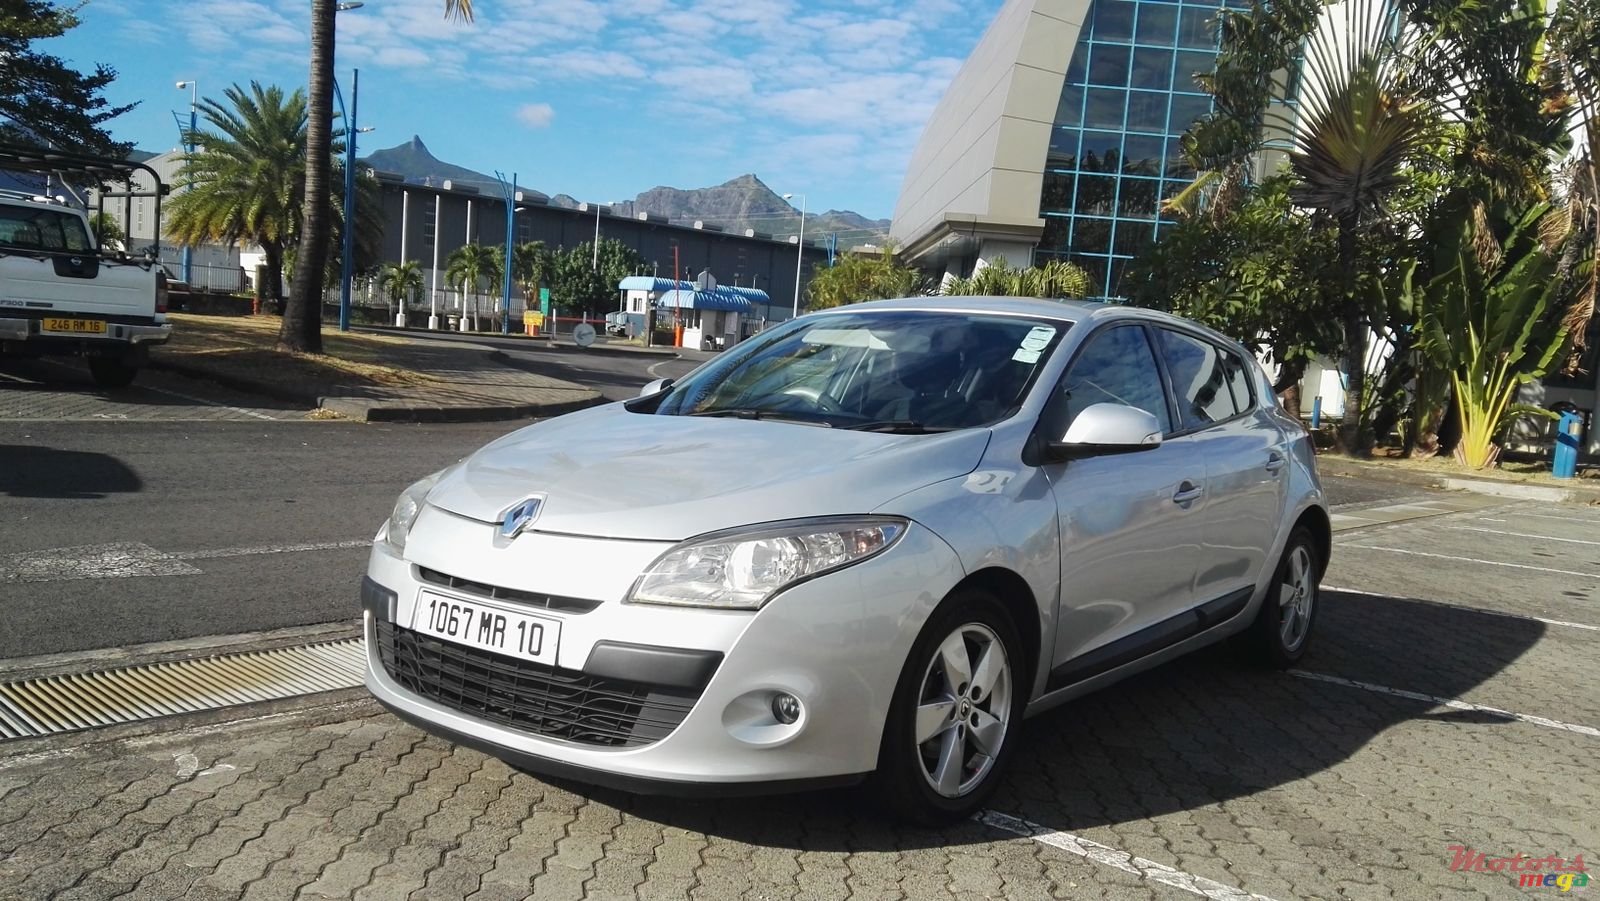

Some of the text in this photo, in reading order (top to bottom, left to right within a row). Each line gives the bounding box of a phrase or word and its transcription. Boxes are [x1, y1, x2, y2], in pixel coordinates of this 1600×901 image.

[51, 319, 70, 330] 246
[89, 321, 101, 331] 16
[429, 599, 544, 656] 1067 MR 10
